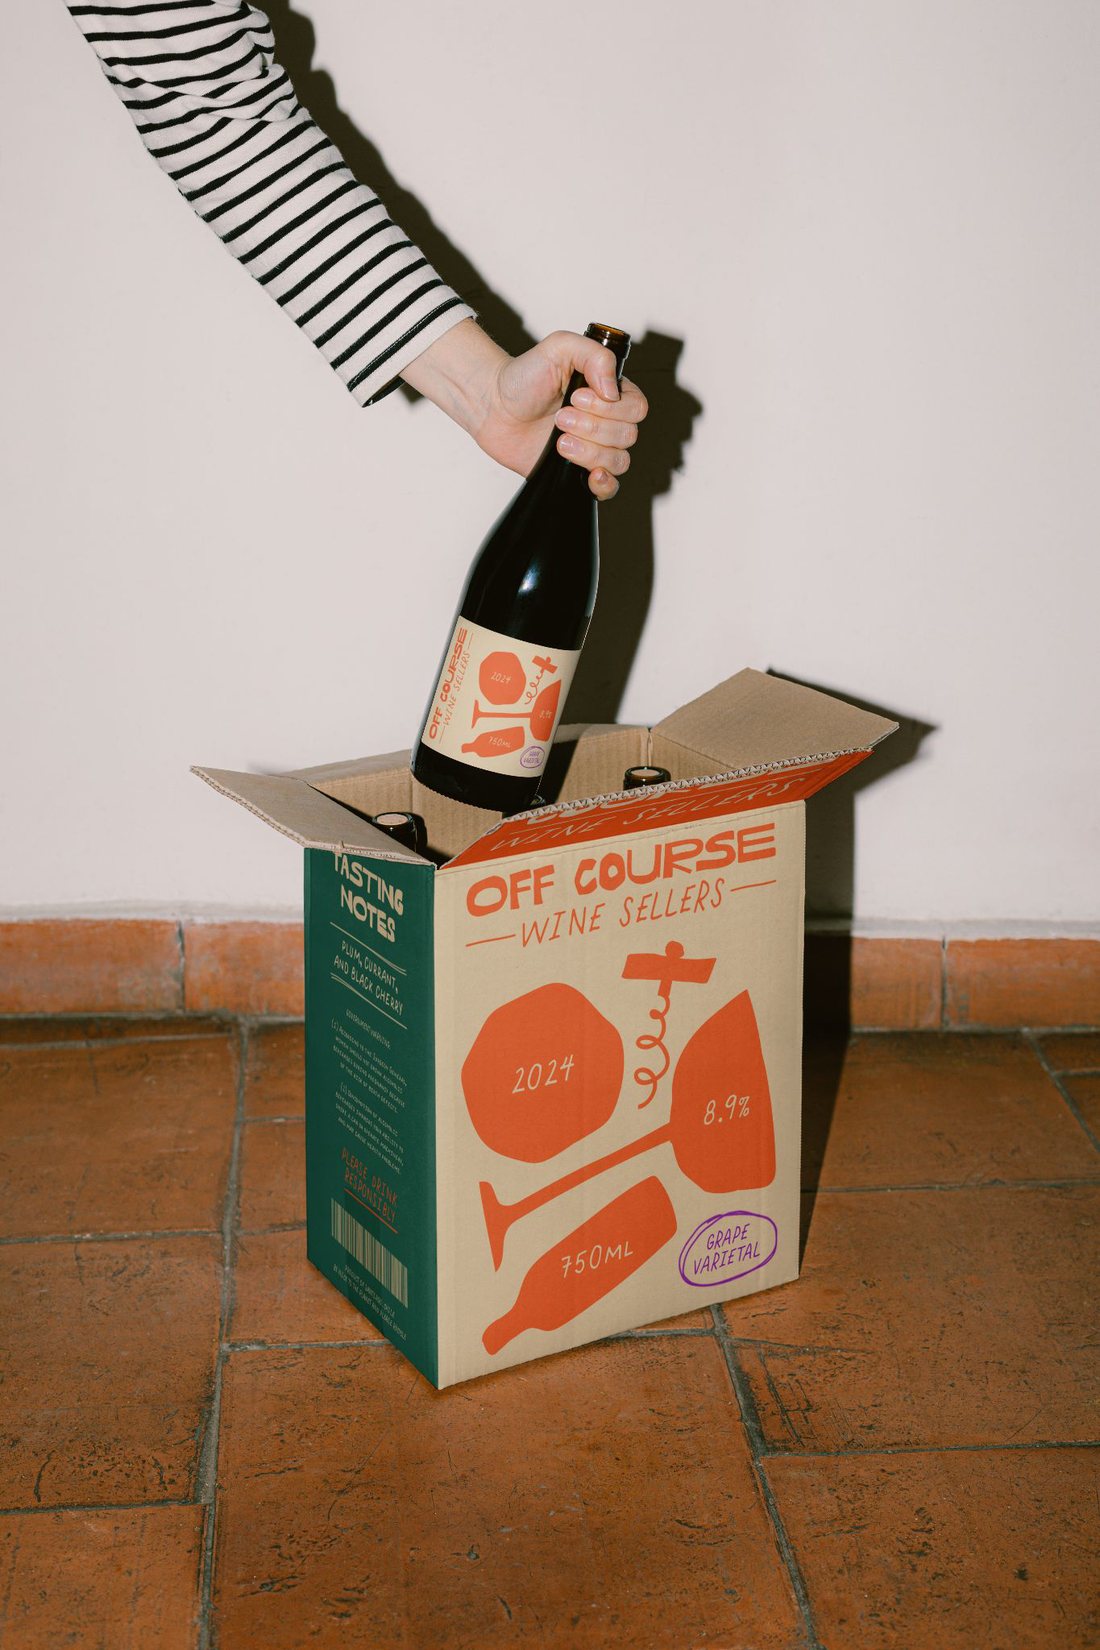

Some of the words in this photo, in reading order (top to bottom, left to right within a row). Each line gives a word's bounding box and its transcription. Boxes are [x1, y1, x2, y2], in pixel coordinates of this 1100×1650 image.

[429, 707, 443, 739] OFF
[440, 627, 467, 702] COURSE
[444, 697, 456, 725] WINE
[454, 652, 470, 691] SELLERS
[490, 816, 606, 851] WINE
[623, 778, 805, 825] SELLERS
[333, 852, 403, 916] TASTING
[466, 864, 555, 917] OFF
[574, 822, 776, 895] COURSE
[341, 885, 395, 942] NOTES
[522, 902, 605, 948] WINE
[620, 878, 725, 928] SELLERS
[334, 955, 348, 974] AND
[352, 968, 372, 993] BLACK
[376, 983, 403, 1016] CHERRY
[512, 1054, 575, 1094] 2024
[703, 1094, 750, 1125] 8.9%
[341, 1147, 367, 1178] PLEASE
[372, 1176, 398, 1207] DRINK
[345, 1172, 396, 1224] RESPONSIBLY
[561, 1241, 634, 1278] 750ML
[693, 1241, 761, 1275] VARIETAL
[706, 1223, 750, 1250] GRAPE
